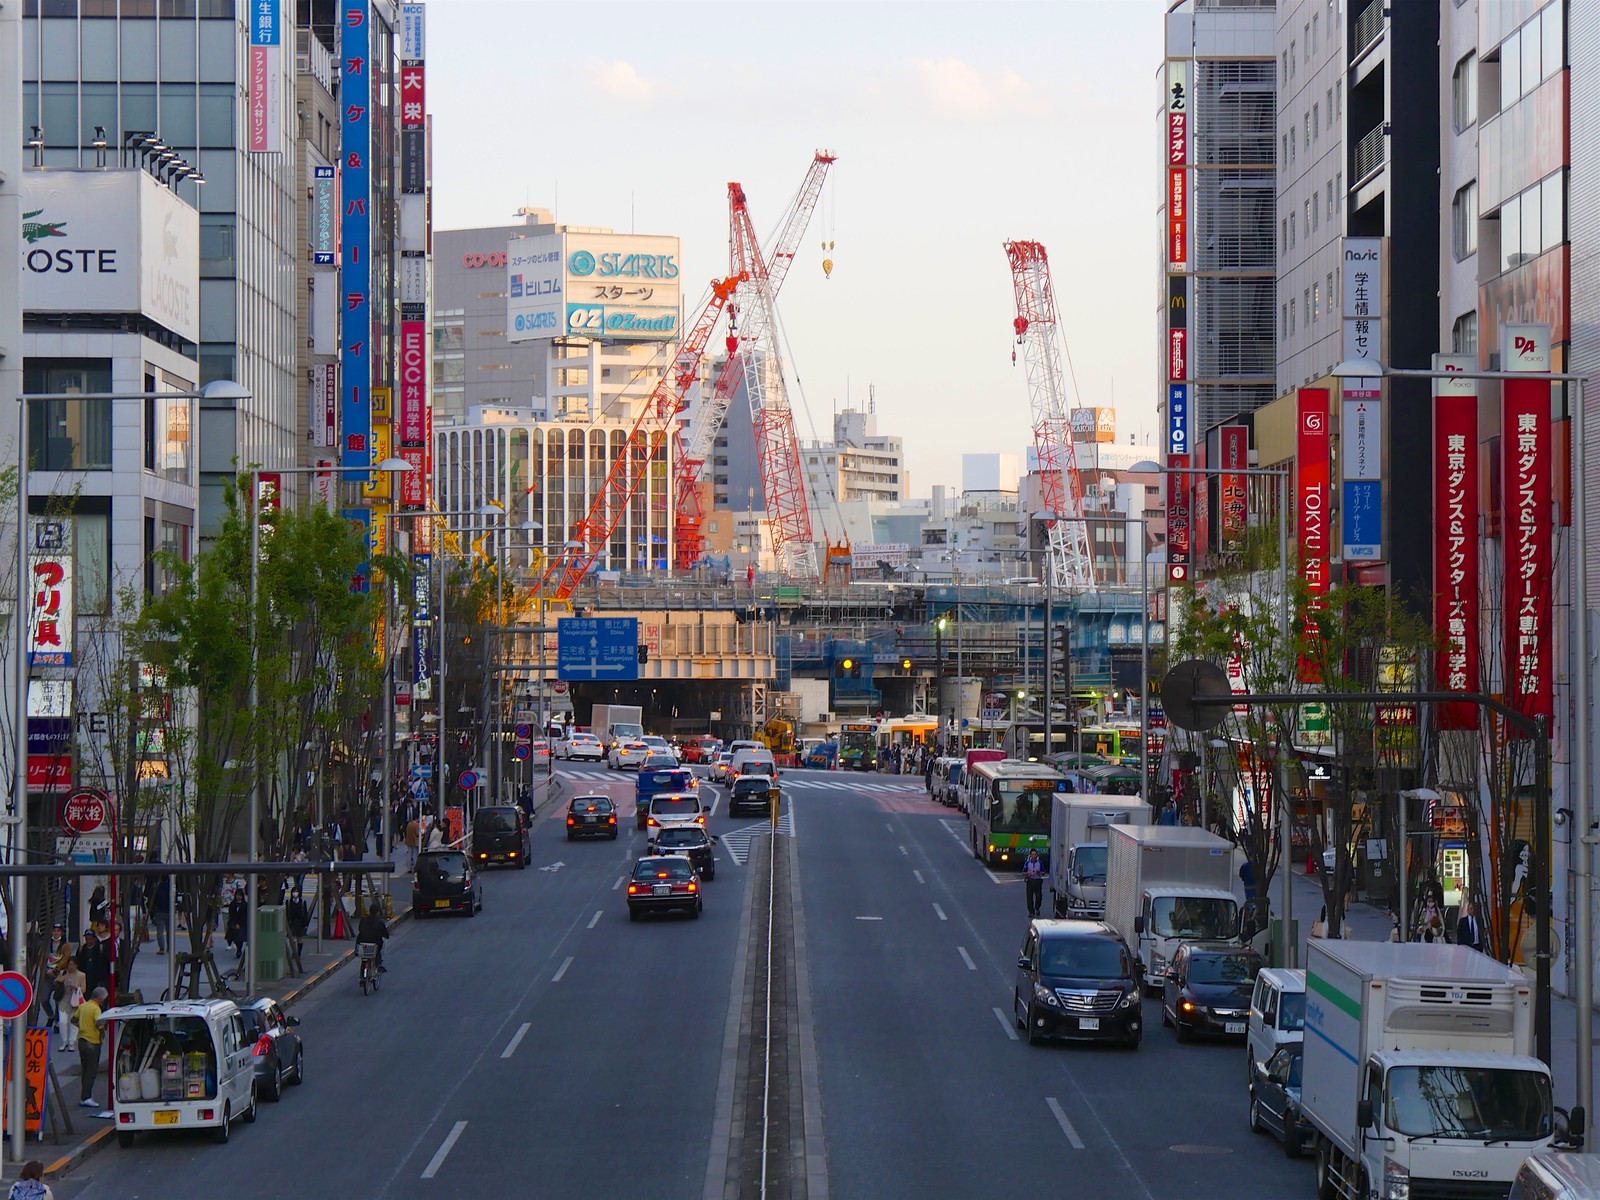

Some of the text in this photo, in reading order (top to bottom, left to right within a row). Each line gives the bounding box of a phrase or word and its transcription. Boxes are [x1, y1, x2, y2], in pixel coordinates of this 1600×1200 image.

[258, 0, 272, 43] 生銀行
[403, 6, 422, 14] MCC
[255, 51, 263, 144] ファッション人材リンク
[404, 71, 422, 120] 大栄
[1171, 82, 1185, 110] えん
[1172, 114, 1185, 162] カラオケ
[318, 169, 332, 177] 長井
[319, 181, 331, 251] ダンス・スタジオ
[23, 249, 118, 273] OSTE
[319, 255, 330, 263] 7F
[512, 251, 560, 266] スターツのビル管理
[600, 252, 679, 279] STARTS
[151, 265, 190, 327] LACOSTE
[525, 278, 562, 296] ビルコム
[595, 285, 654, 300] スターツ
[570, 309, 603, 328] OZ
[1355, 272, 1369, 388] 学生情報センー
[1358, 413, 1366, 477] 三菱地所ハウスネット
[1223, 485, 1245, 532] 北海道
[1363, 485, 1371, 510] ワコール
[1169, 506, 1188, 548] 北海道
[1353, 515, 1361, 542] サービス
[1173, 554, 1185, 562] 3F
[33, 562, 65, 647] つり具
[562, 619, 598, 630] 天現寺橋
[604, 620, 630, 630] 恵比寿
[561, 646, 586, 656] 三宅坂
[603, 646, 634, 655] 三軒茶屋
[69, 806, 101, 820] 消火栓
[27, 1061, 40, 1073] 先
[1453, 1170, 1489, 1178] ISUZU
